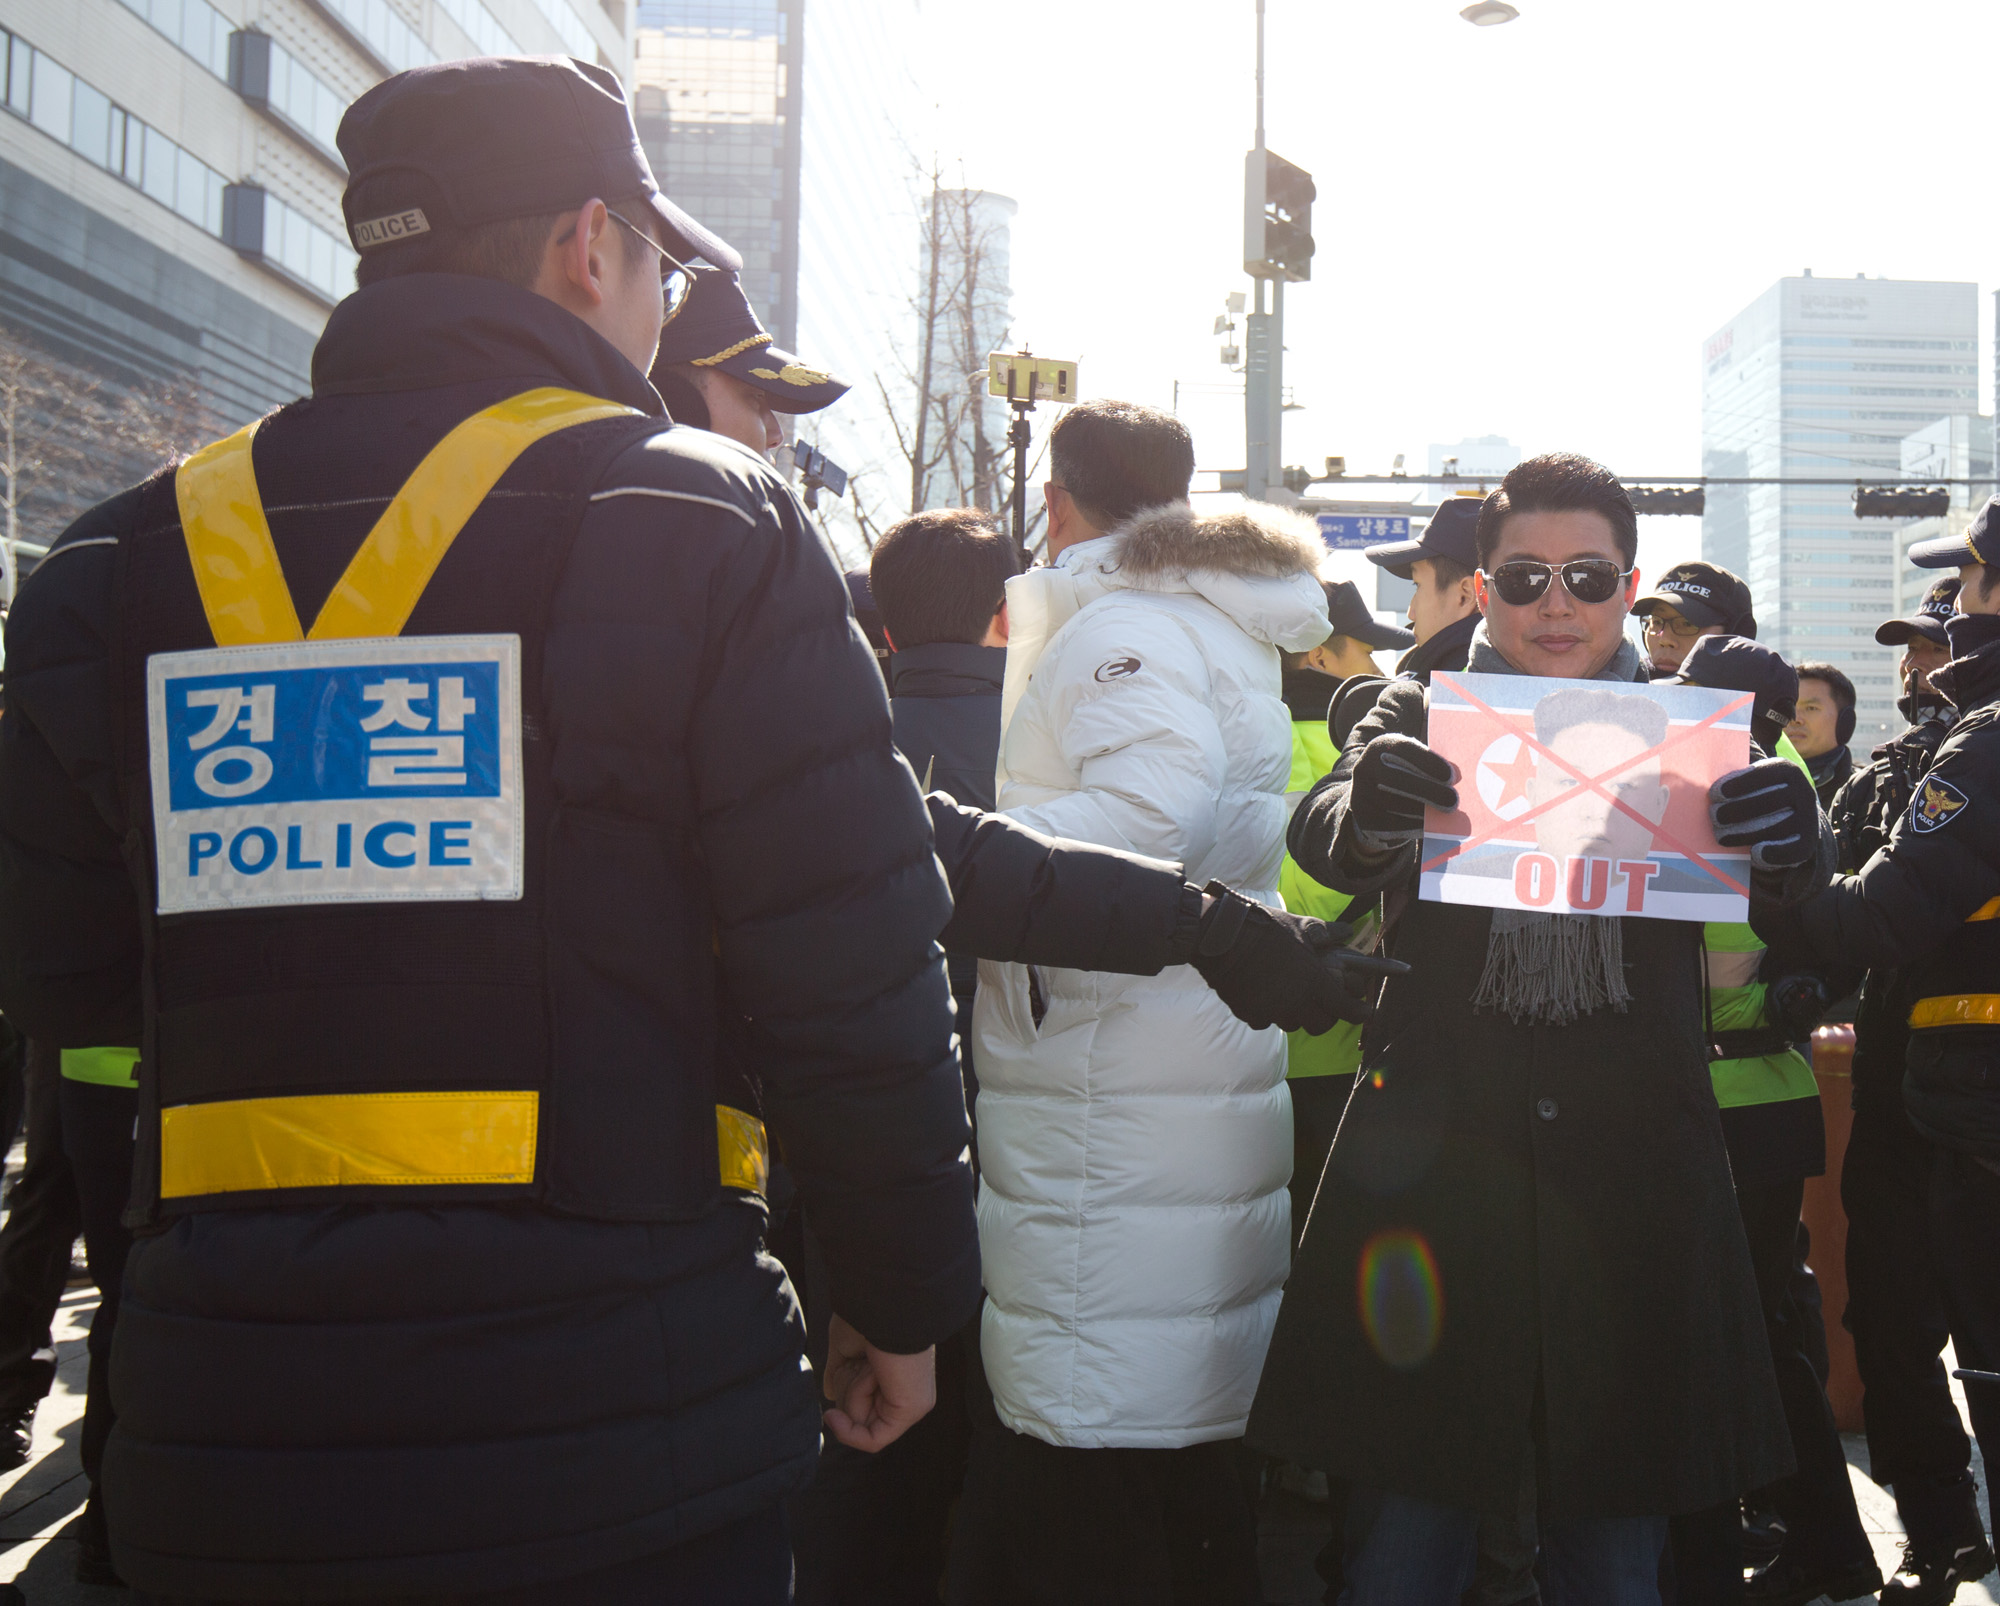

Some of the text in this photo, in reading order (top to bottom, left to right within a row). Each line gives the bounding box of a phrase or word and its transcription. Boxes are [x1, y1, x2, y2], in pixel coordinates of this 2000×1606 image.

[1356, 518, 1406, 536] 삼봉로
[1659, 581, 1711, 599] POLICE
[186, 677, 476, 799] 경 찰
[1916, 812, 1935, 828] POLICE
[188, 820, 473, 877] POLICE
[1514, 852, 1659, 912] OUT
